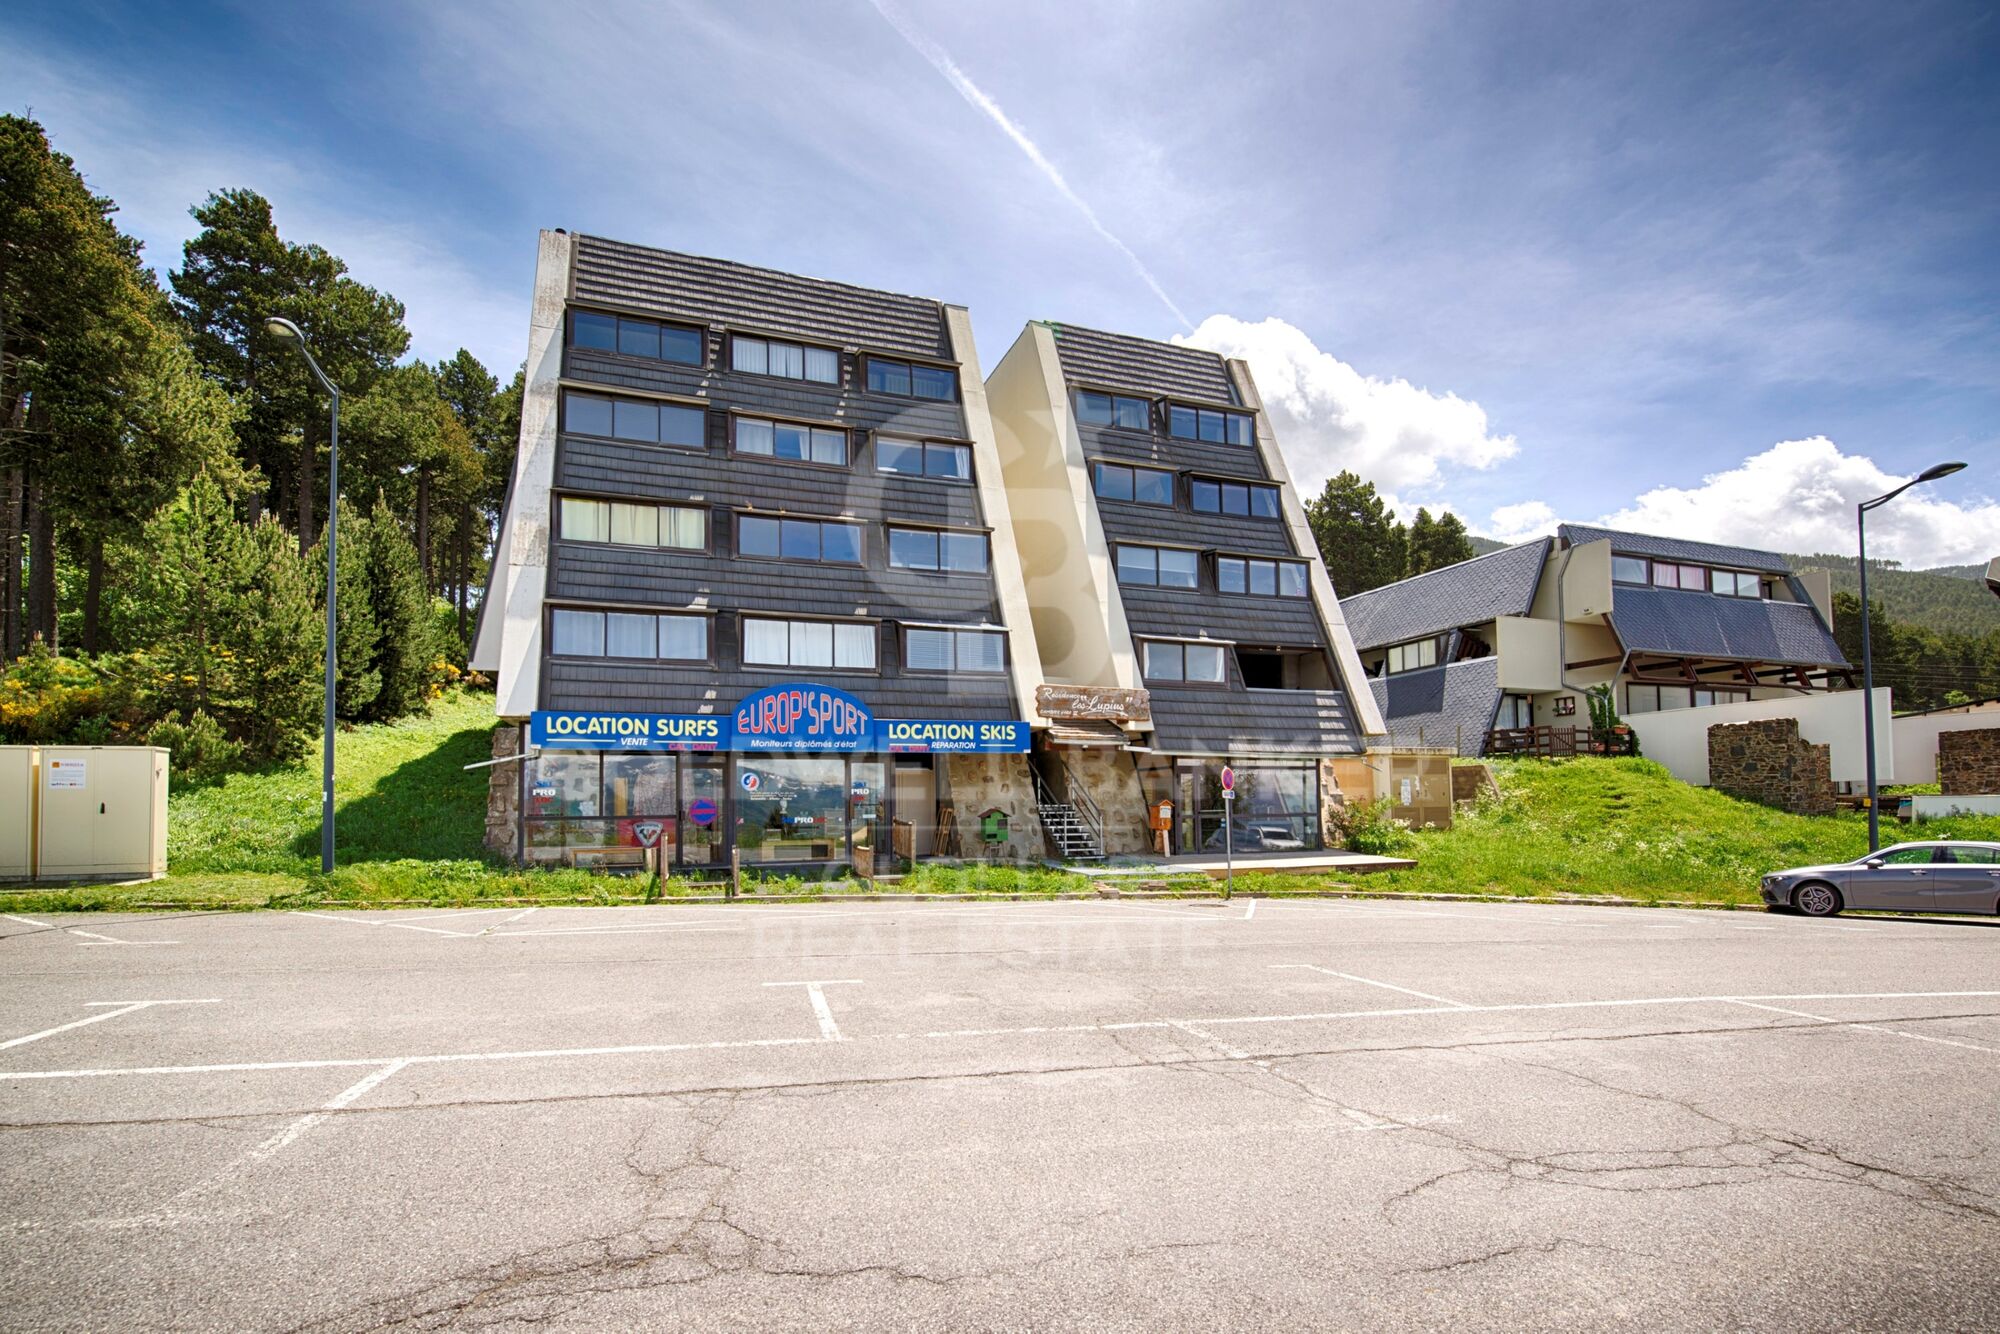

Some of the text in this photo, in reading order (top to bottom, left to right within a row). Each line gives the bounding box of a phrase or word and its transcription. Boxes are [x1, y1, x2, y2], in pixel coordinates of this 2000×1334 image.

[737, 690, 868, 736] EUROP'SPORT
[546, 716, 718, 737] LOCATION SURFS
[889, 723, 1016, 740] LOCATION SKIS
[620, 738, 649, 746] VENTE
[750, 739, 857, 749] Moniteurs diplômés d'état
[931, 741, 976, 749] REPARATION
